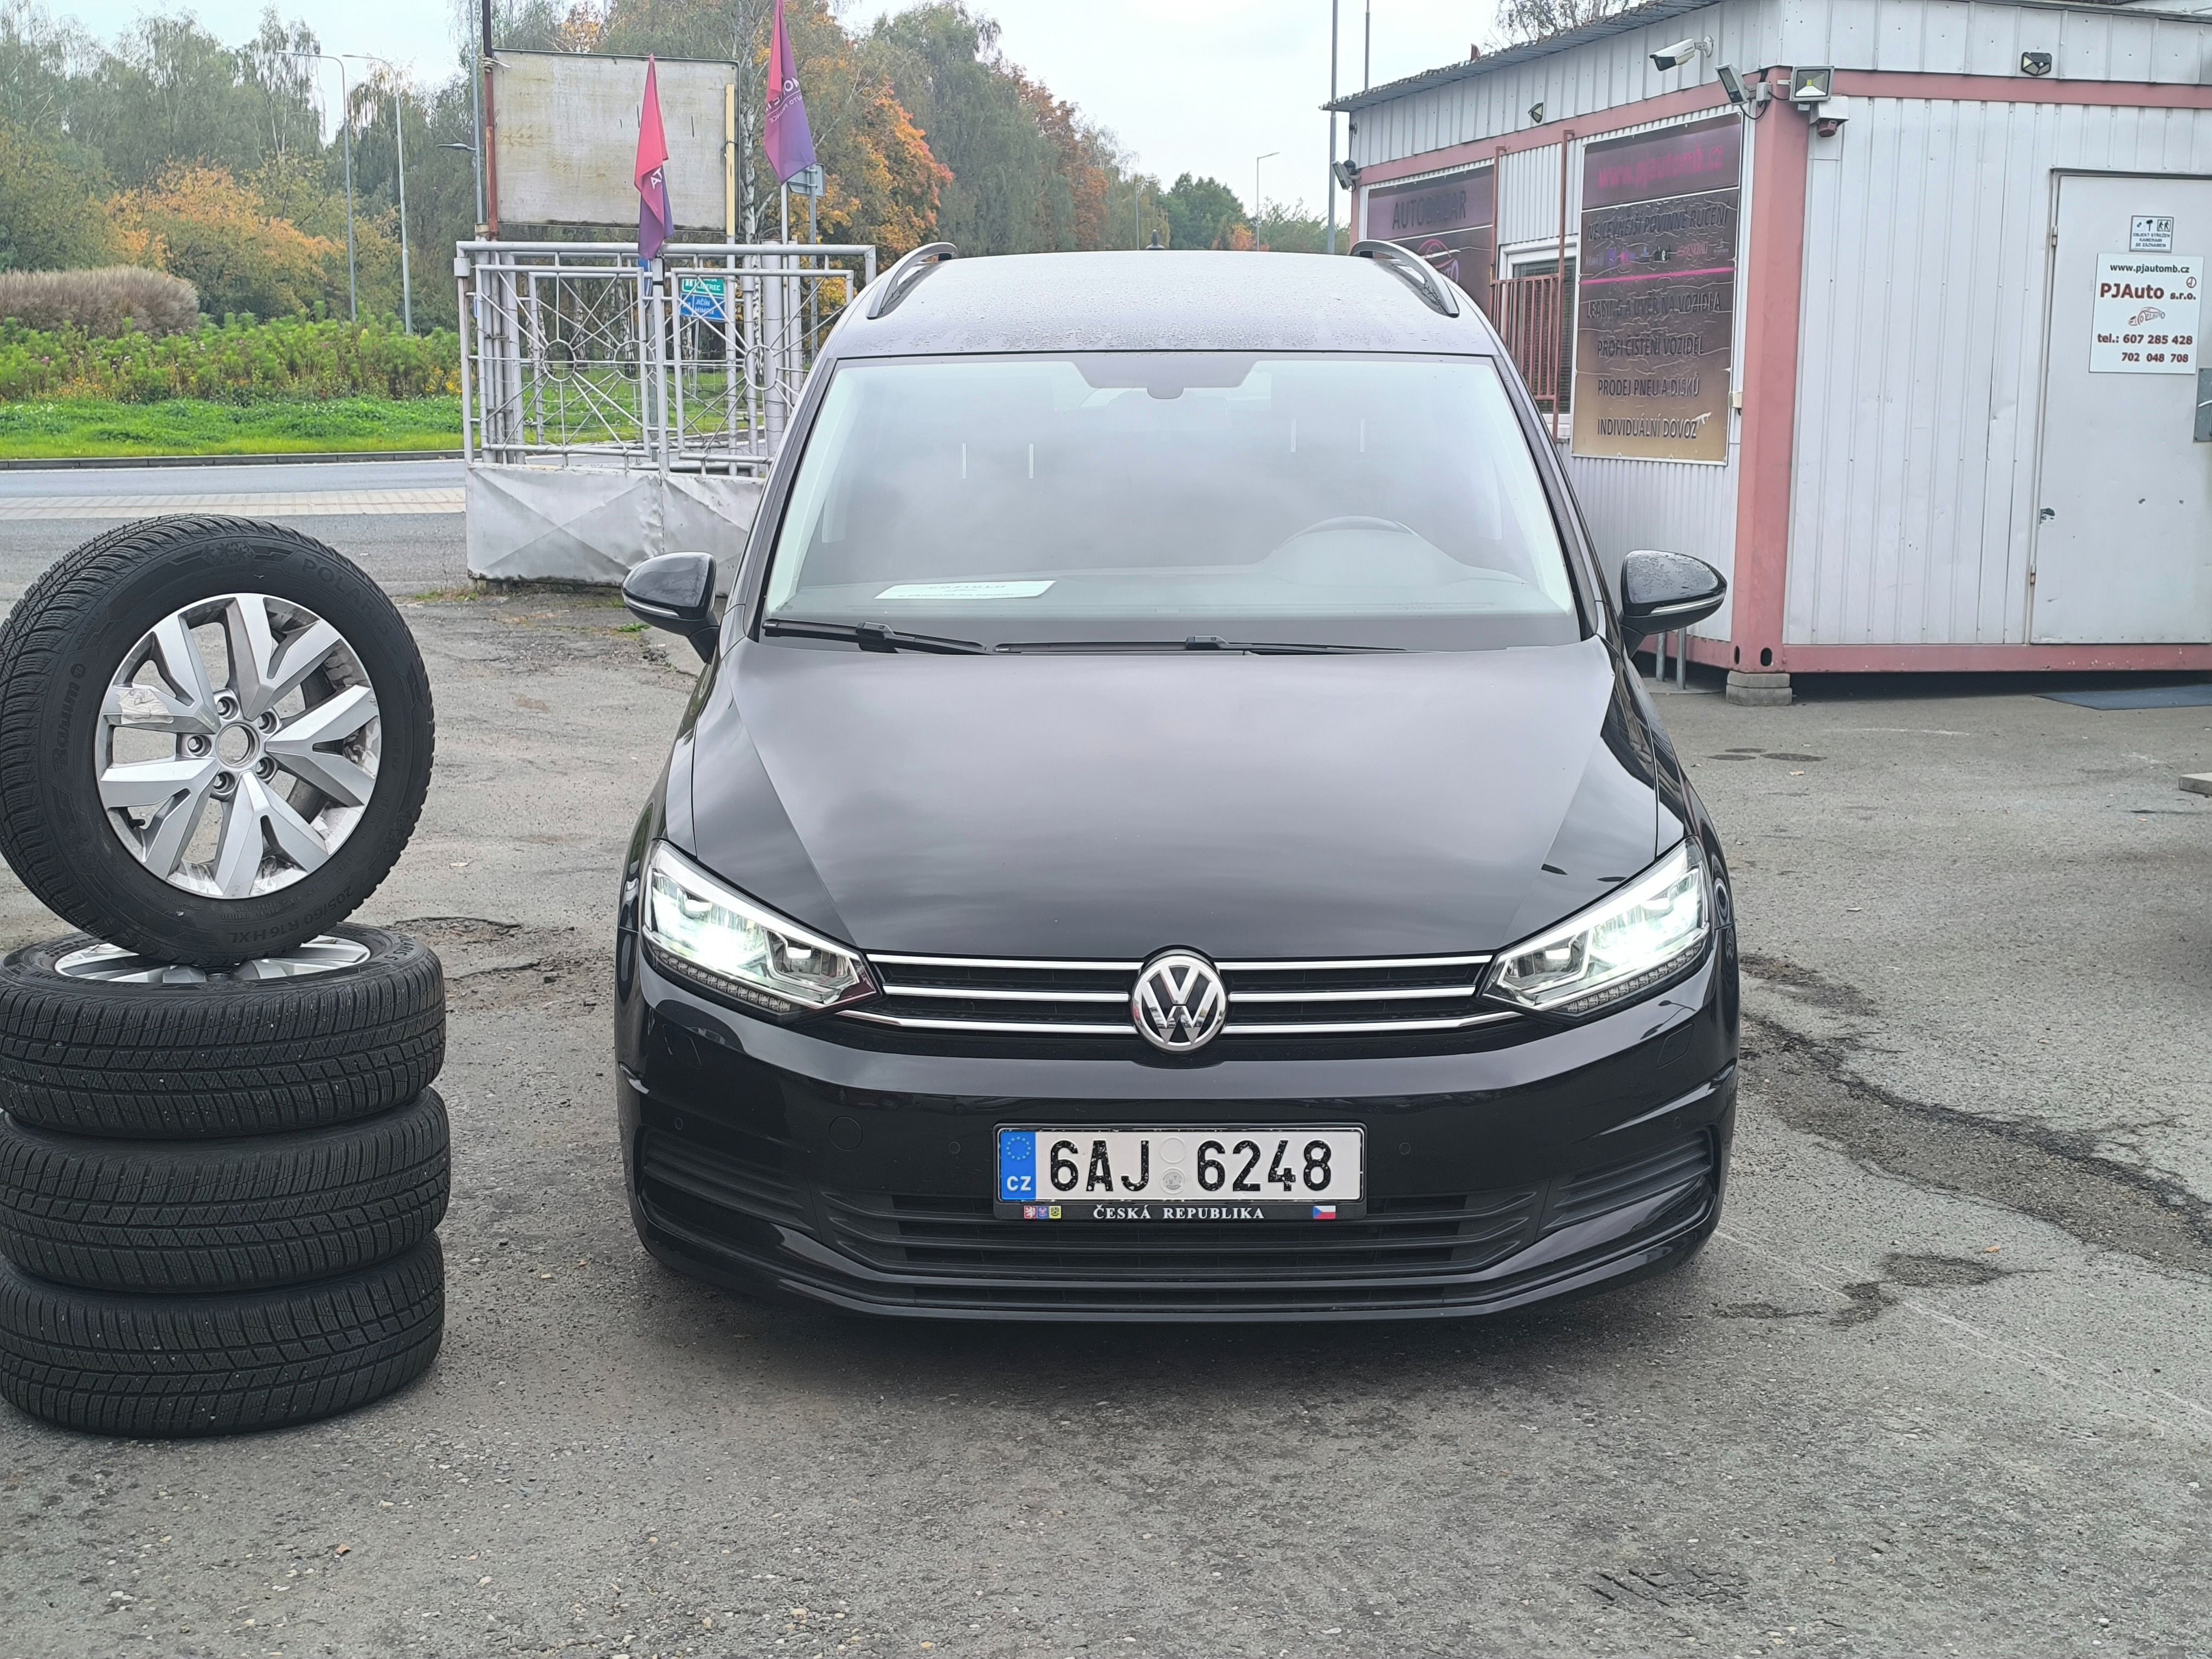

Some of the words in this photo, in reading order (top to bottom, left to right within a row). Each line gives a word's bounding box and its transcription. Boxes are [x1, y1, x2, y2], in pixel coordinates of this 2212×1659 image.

[2110, 263, 2190, 274] www.pjautomb.cz
[2100, 282, 2165, 299] PJAuto
[2170, 292, 2196, 300] s.r.o.
[1662, 336, 1704, 356] VOZIDEL
[2097, 333, 2120, 343] tel.:
[2123, 333, 2144, 344] 607
[2147, 335, 2169, 344] 285
[2172, 335, 2193, 345] 428
[2121, 352, 2140, 362] 702
[2146, 353, 2165, 362] 048
[2170, 353, 2189, 363] 708
[1598, 379, 1631, 397] PRODEJ
[1634, 378, 1659, 396] PNEU
[1670, 371, 1700, 397] DISKŮ
[1597, 413, 1662, 438] INDIVIDUÁLNÍ
[1663, 419, 1697, 439] DOVOZ
[1006, 1175, 1032, 1192] CZ
[1050, 1139, 1150, 1192] 6AJ
[1197, 1139, 1333, 1193] 6248
[1092, 1203, 1153, 1220] ČESKÁ
[1162, 1207, 1265, 1220] REPUBLIKA
